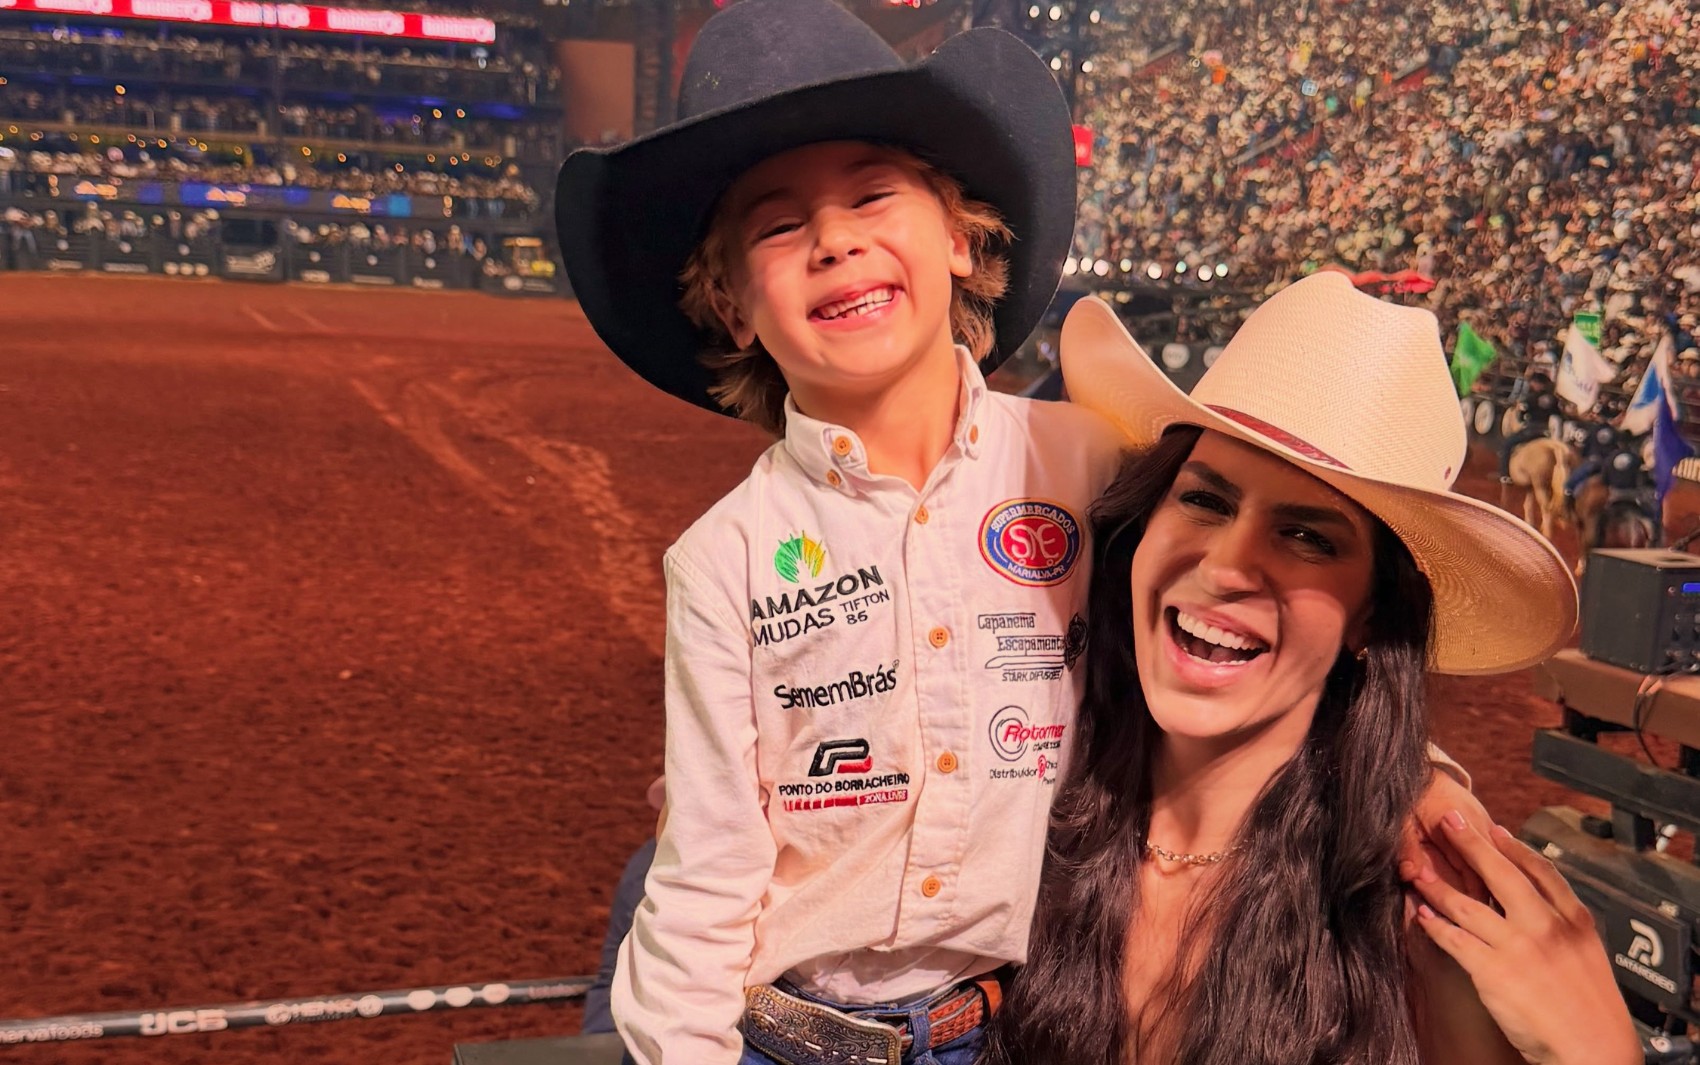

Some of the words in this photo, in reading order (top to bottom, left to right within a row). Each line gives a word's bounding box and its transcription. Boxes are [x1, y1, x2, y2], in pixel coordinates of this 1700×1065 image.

[990, 505, 1075, 532] SUPERMERCADOS
[751, 565, 884, 620] AMAZON
[839, 589, 890, 613] TIFTON
[751, 607, 836, 648] MUDAS
[977, 612, 1037, 635] Capanema
[778, 783, 814, 797] PONTO
[815, 782, 833, 794] DO
